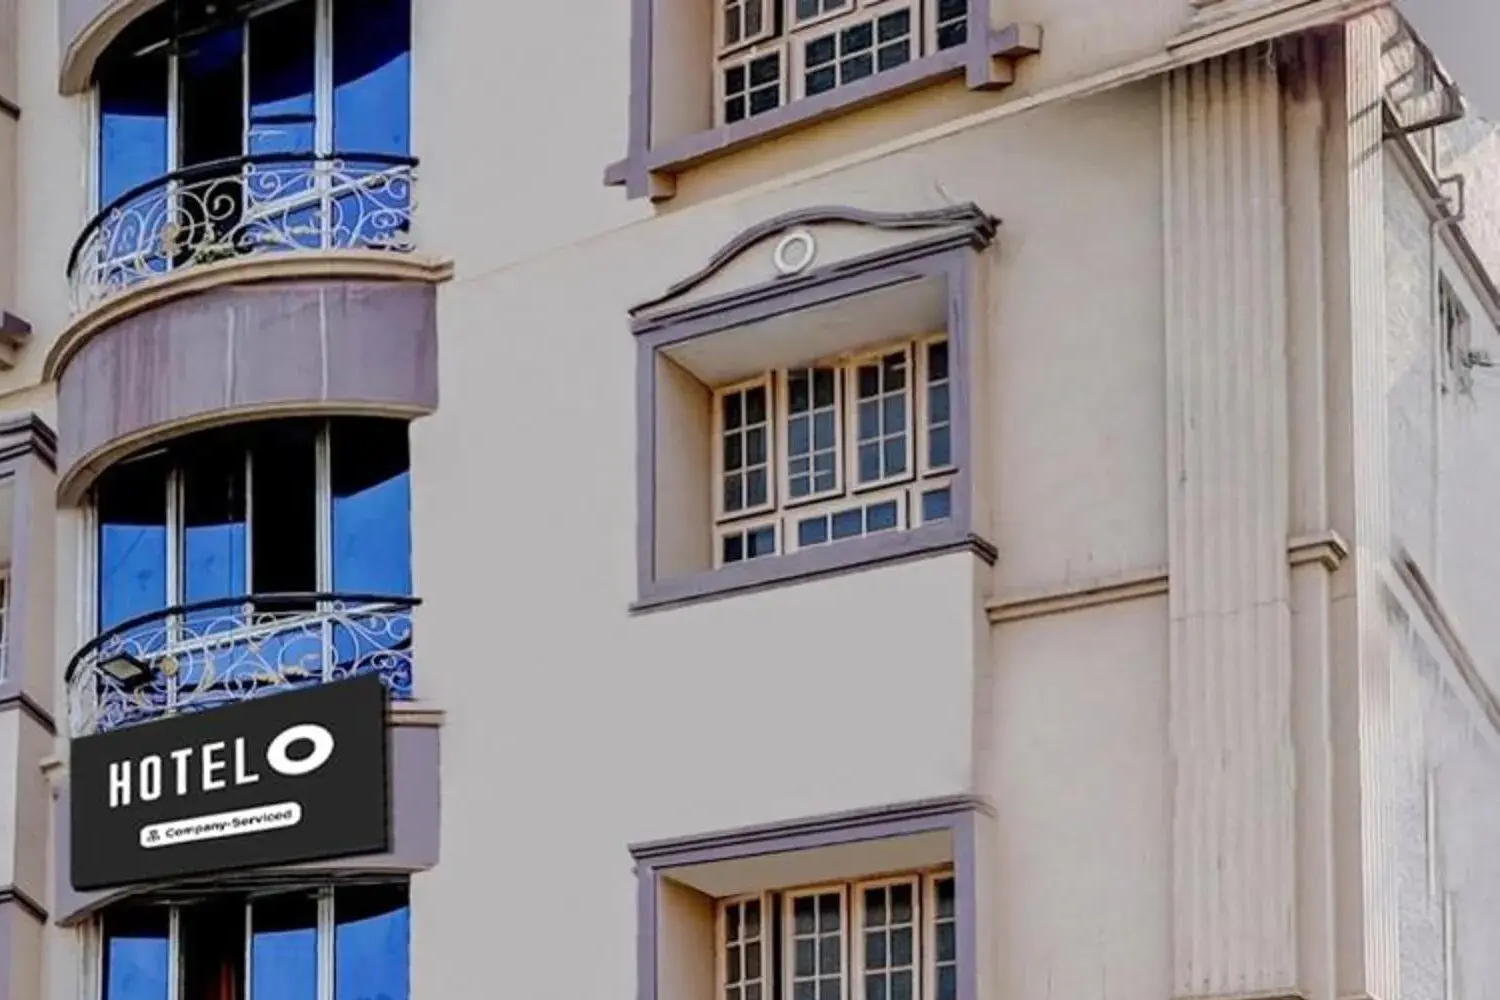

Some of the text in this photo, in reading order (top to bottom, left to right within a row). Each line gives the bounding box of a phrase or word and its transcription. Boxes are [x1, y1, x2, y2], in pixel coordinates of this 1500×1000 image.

[109, 724, 335, 808] HOTEL O
[164, 807, 294, 840] Company-Serviced
